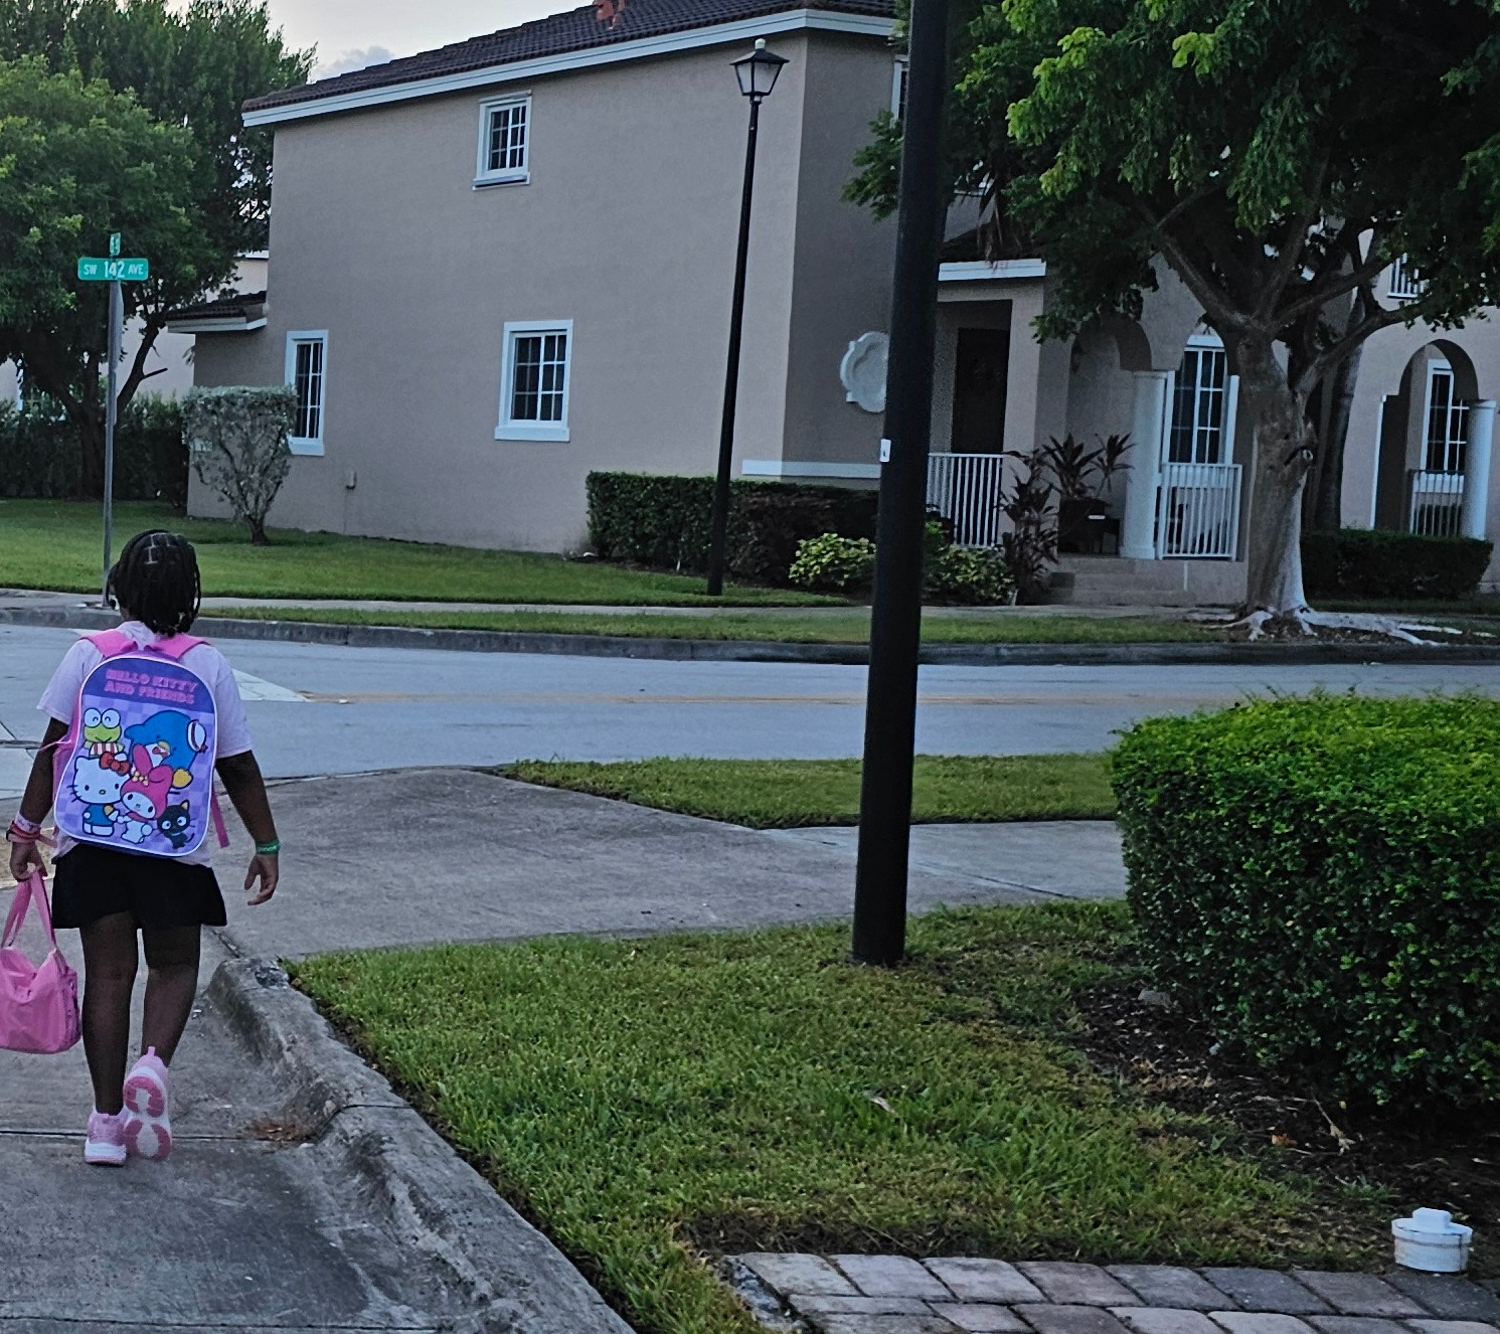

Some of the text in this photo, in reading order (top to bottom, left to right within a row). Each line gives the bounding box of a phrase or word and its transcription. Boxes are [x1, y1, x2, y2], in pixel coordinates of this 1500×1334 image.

[83, 260, 144, 278] SW 142 AVE
[103, 680, 195, 705] AND FRIENDS
[105, 668, 198, 693] HELLO KITTY
